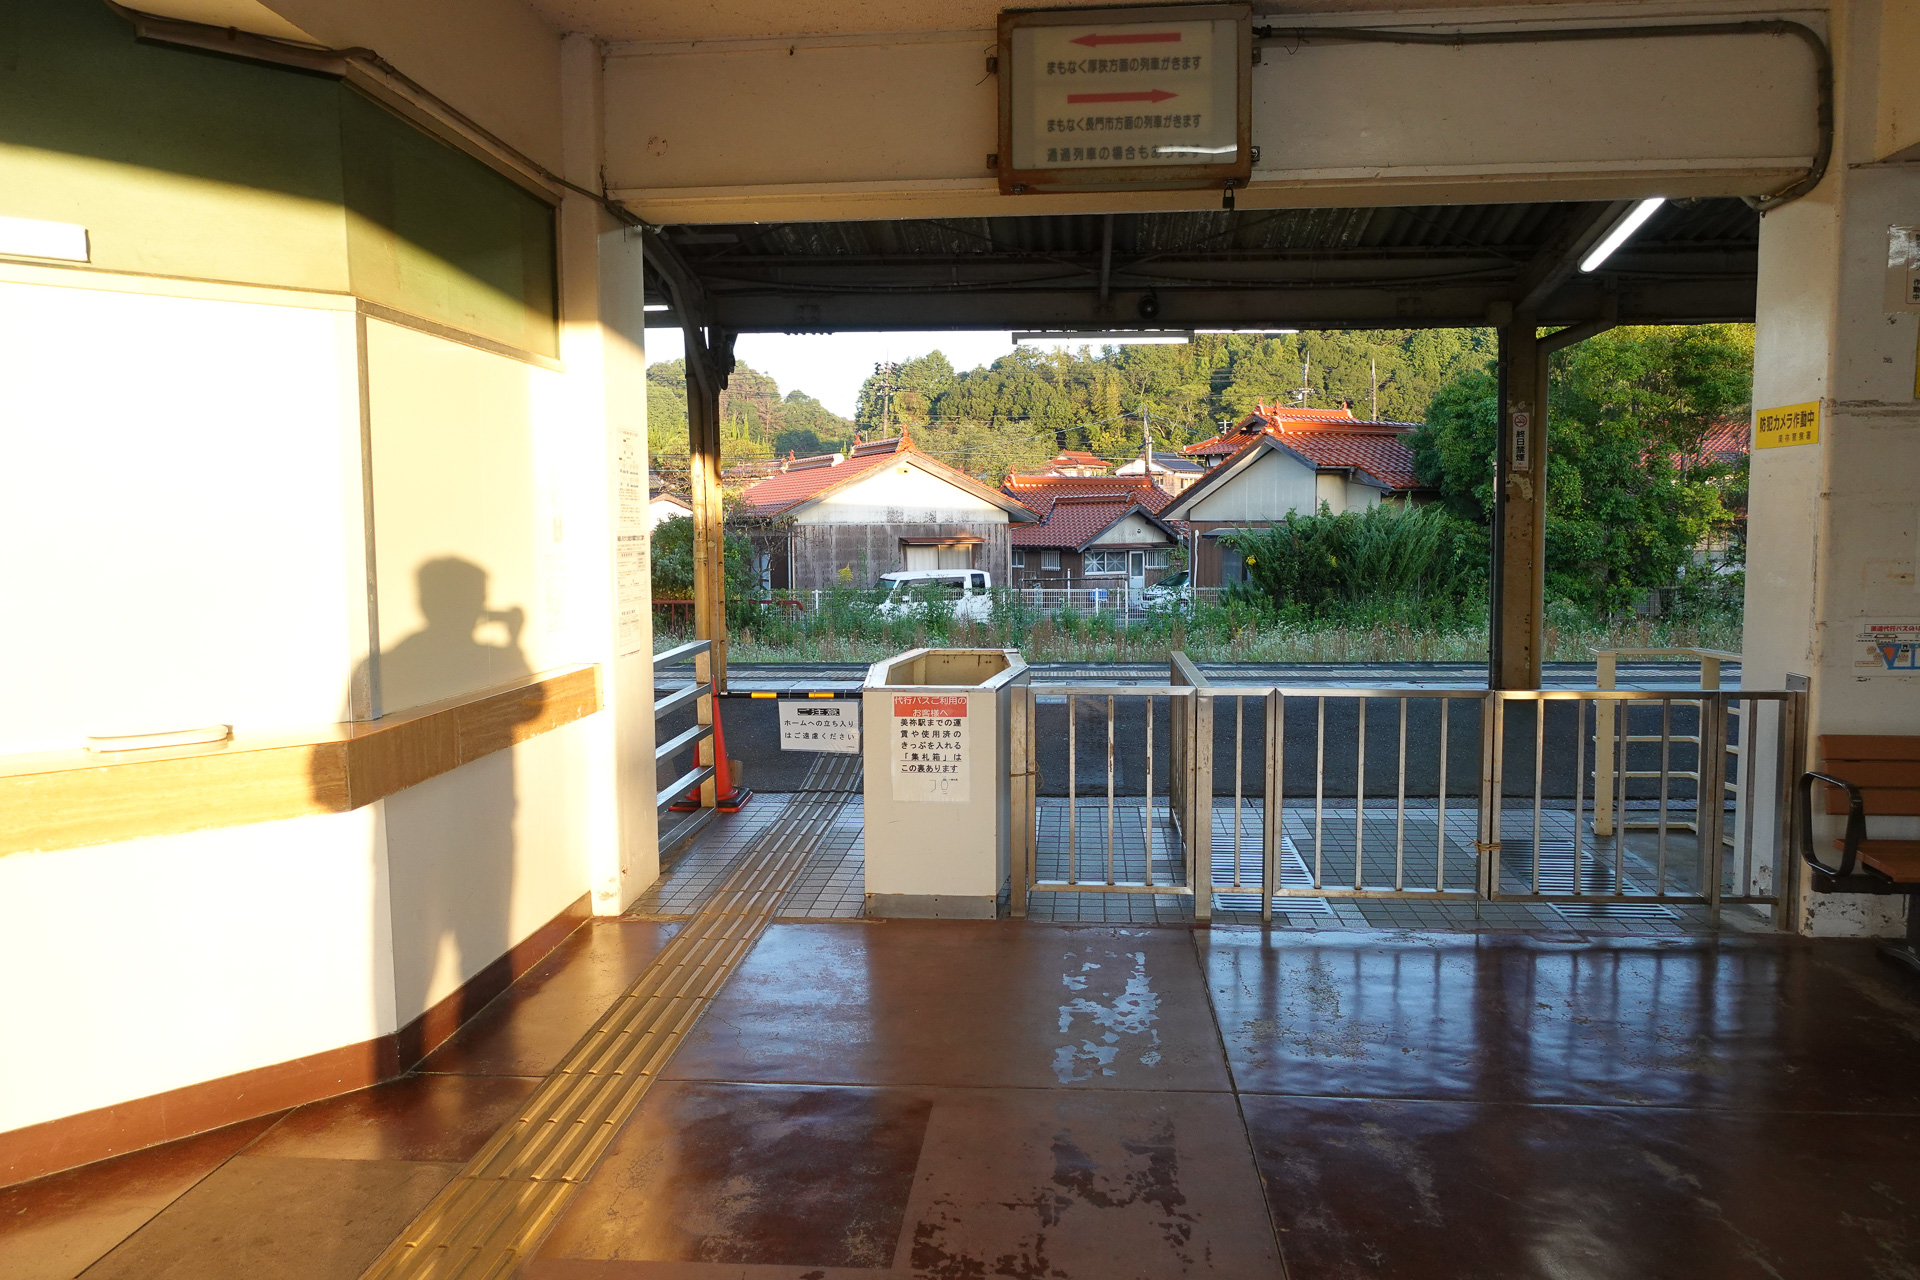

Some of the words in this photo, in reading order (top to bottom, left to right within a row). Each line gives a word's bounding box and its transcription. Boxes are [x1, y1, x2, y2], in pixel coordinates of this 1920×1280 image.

[1047, 114, 1202, 132] まもなく長門市方面の列車がきます
[1759, 410, 1815, 433] 防犯カメラ作動中
[1515, 430, 1526, 461] 終日禁煙
[894, 696, 967, 705] 代行バスご利用の
[912, 709, 949, 717] お客様へ
[784, 720, 854, 728] ホームへの立ち入り
[900, 718, 962, 727] 美祢駅までの運
[784, 732, 855, 740] はご遠慮ください
[900, 730, 962, 738] 賃や使用済の
[904, 752, 962, 761] 「集札箱」は
[901, 764, 958, 773] この裏あります
